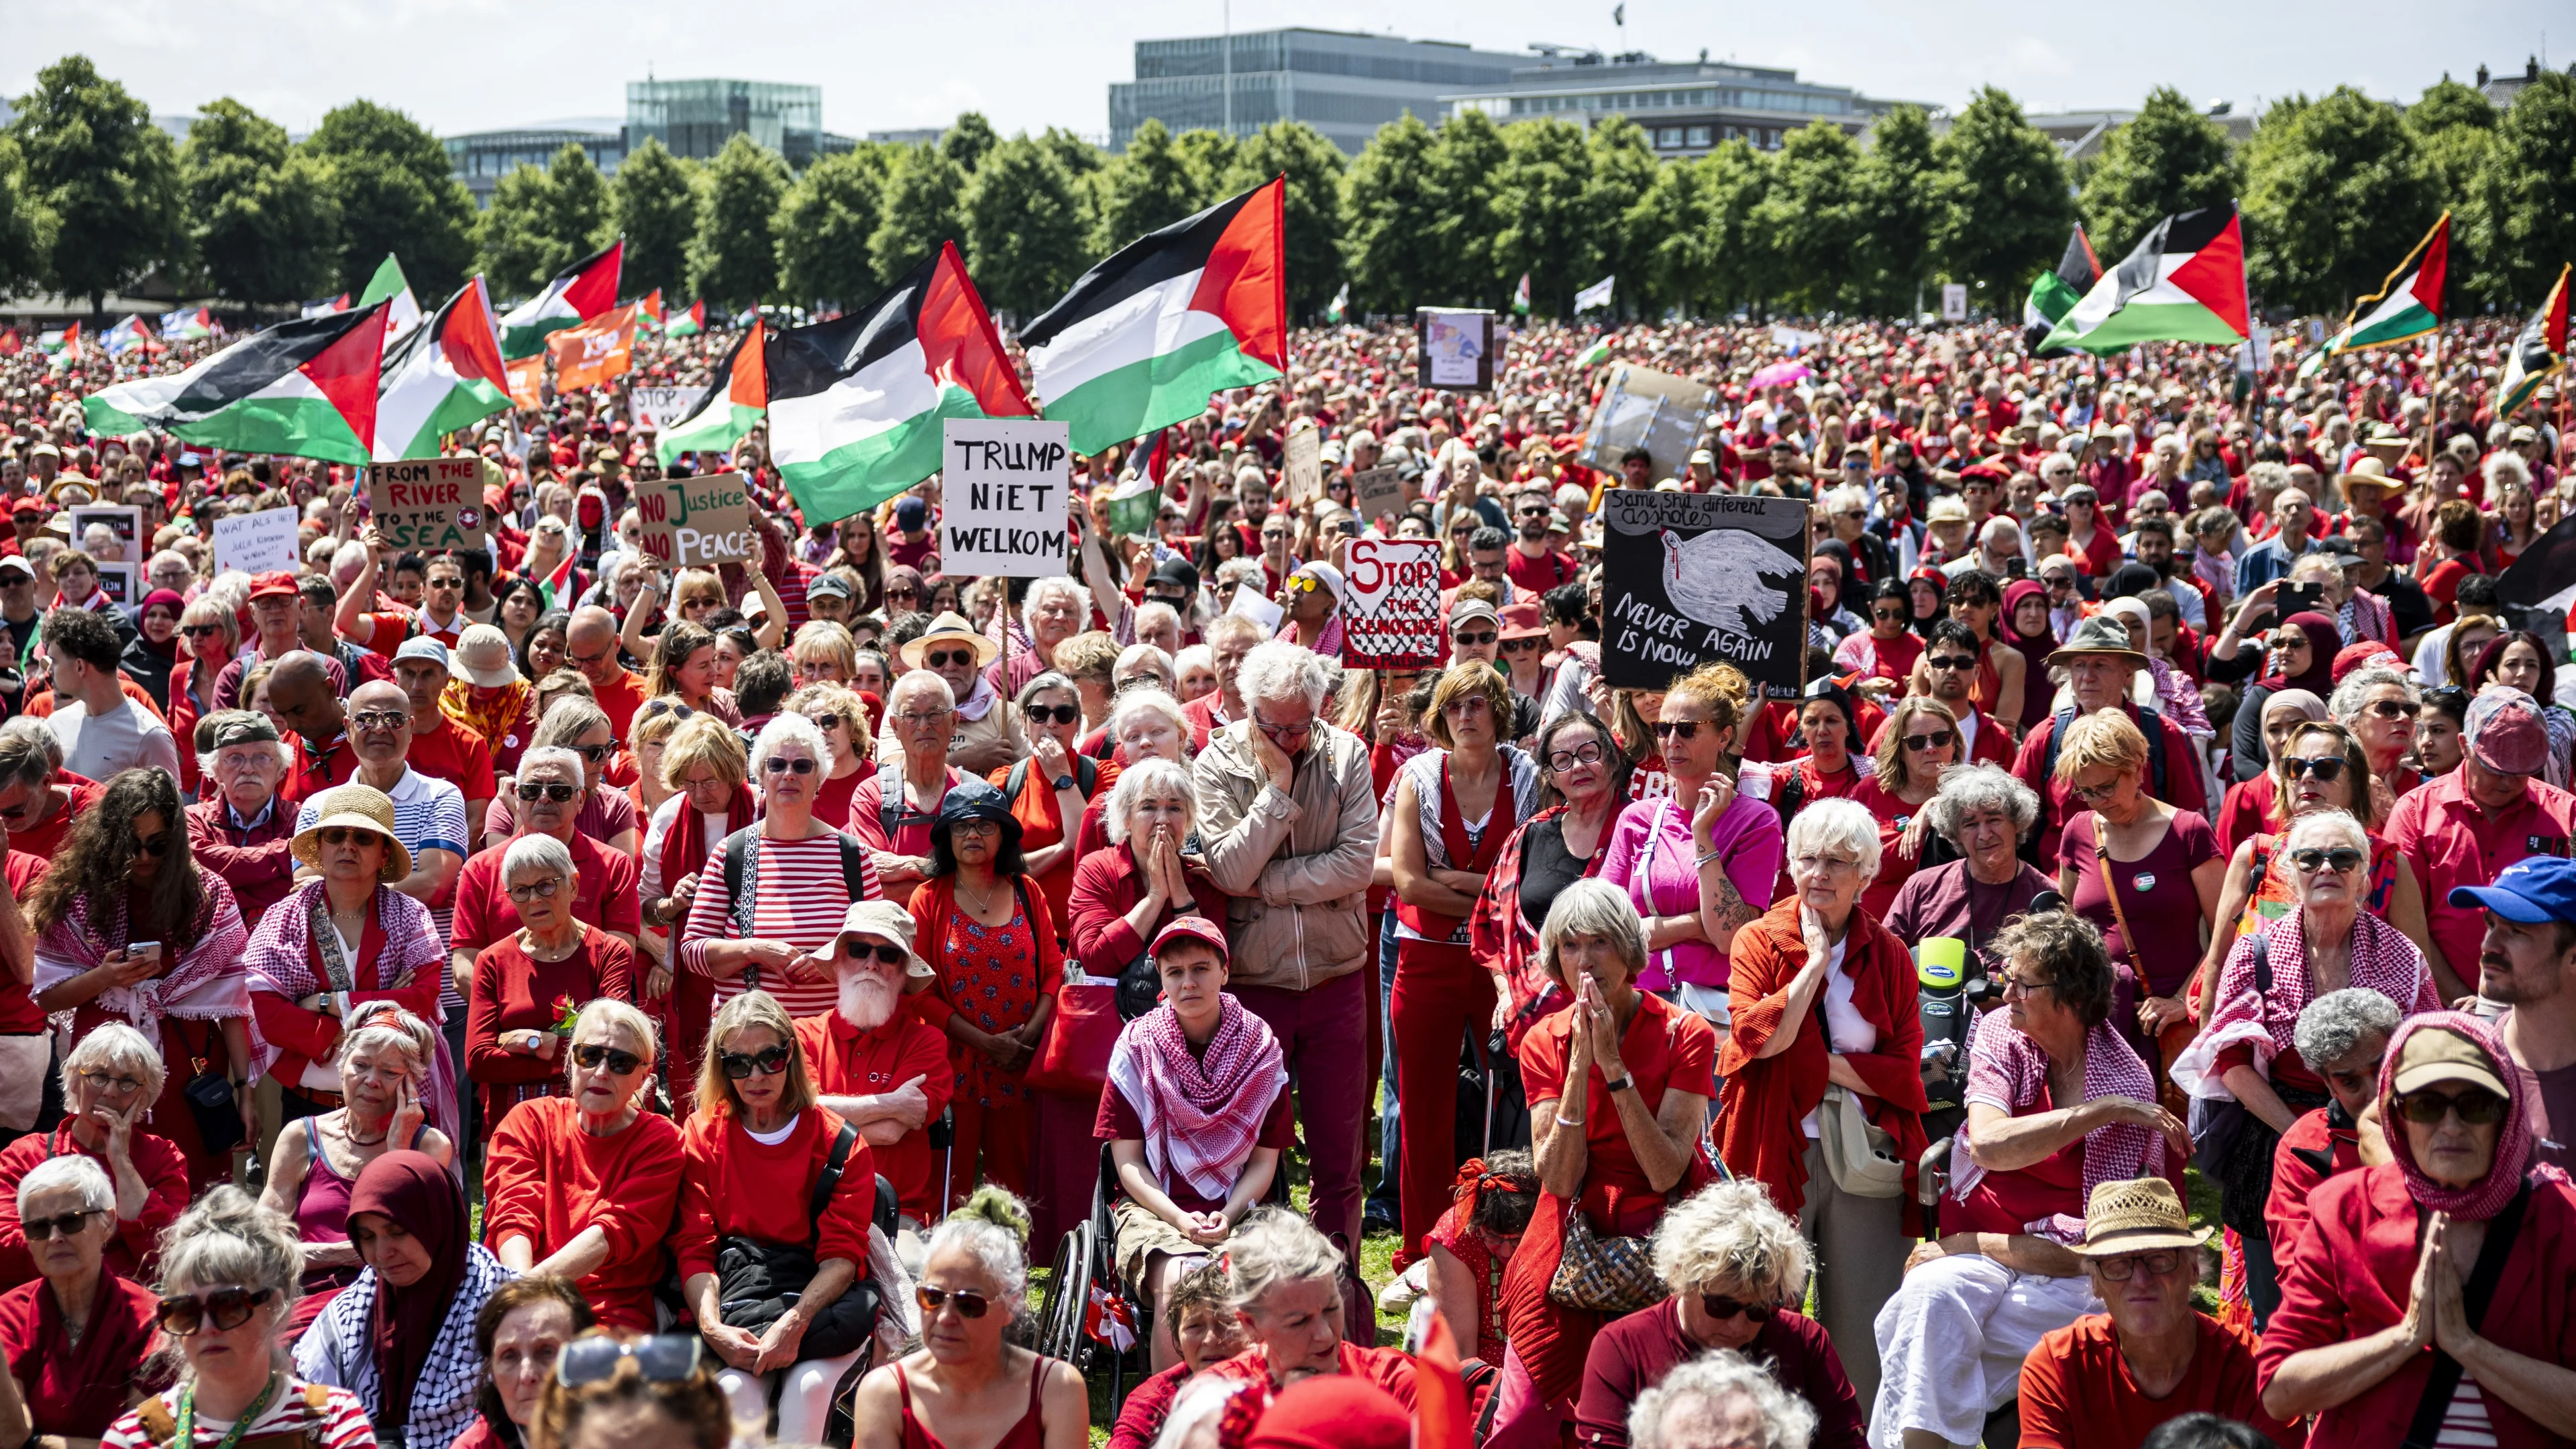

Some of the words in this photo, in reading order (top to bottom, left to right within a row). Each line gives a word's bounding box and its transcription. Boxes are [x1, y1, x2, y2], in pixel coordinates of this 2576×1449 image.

[638, 390, 676, 408] STOP
[953, 439, 1065, 472] TRUMP
[370, 464, 430, 486] FROM
[438, 462, 474, 480] THE
[639, 493, 666, 525] NO
[667, 484, 744, 527] Justice
[1612, 490, 1658, 508] Same
[1703, 496, 1766, 515] different
[219, 520, 245, 535] WAT
[252, 517, 270, 529] ALS
[278, 513, 294, 523] HET
[376, 512, 401, 530] TO
[409, 511, 446, 528] THE
[388, 523, 465, 548] SEA
[643, 532, 671, 562] NO
[950, 527, 1066, 559] WELKOM
[1386, 598, 1421, 612] THE
[1613, 592, 1690, 639] NEVER
[1351, 616, 1439, 636] GENOCIDE
[1641, 637, 1697, 666] NOW
